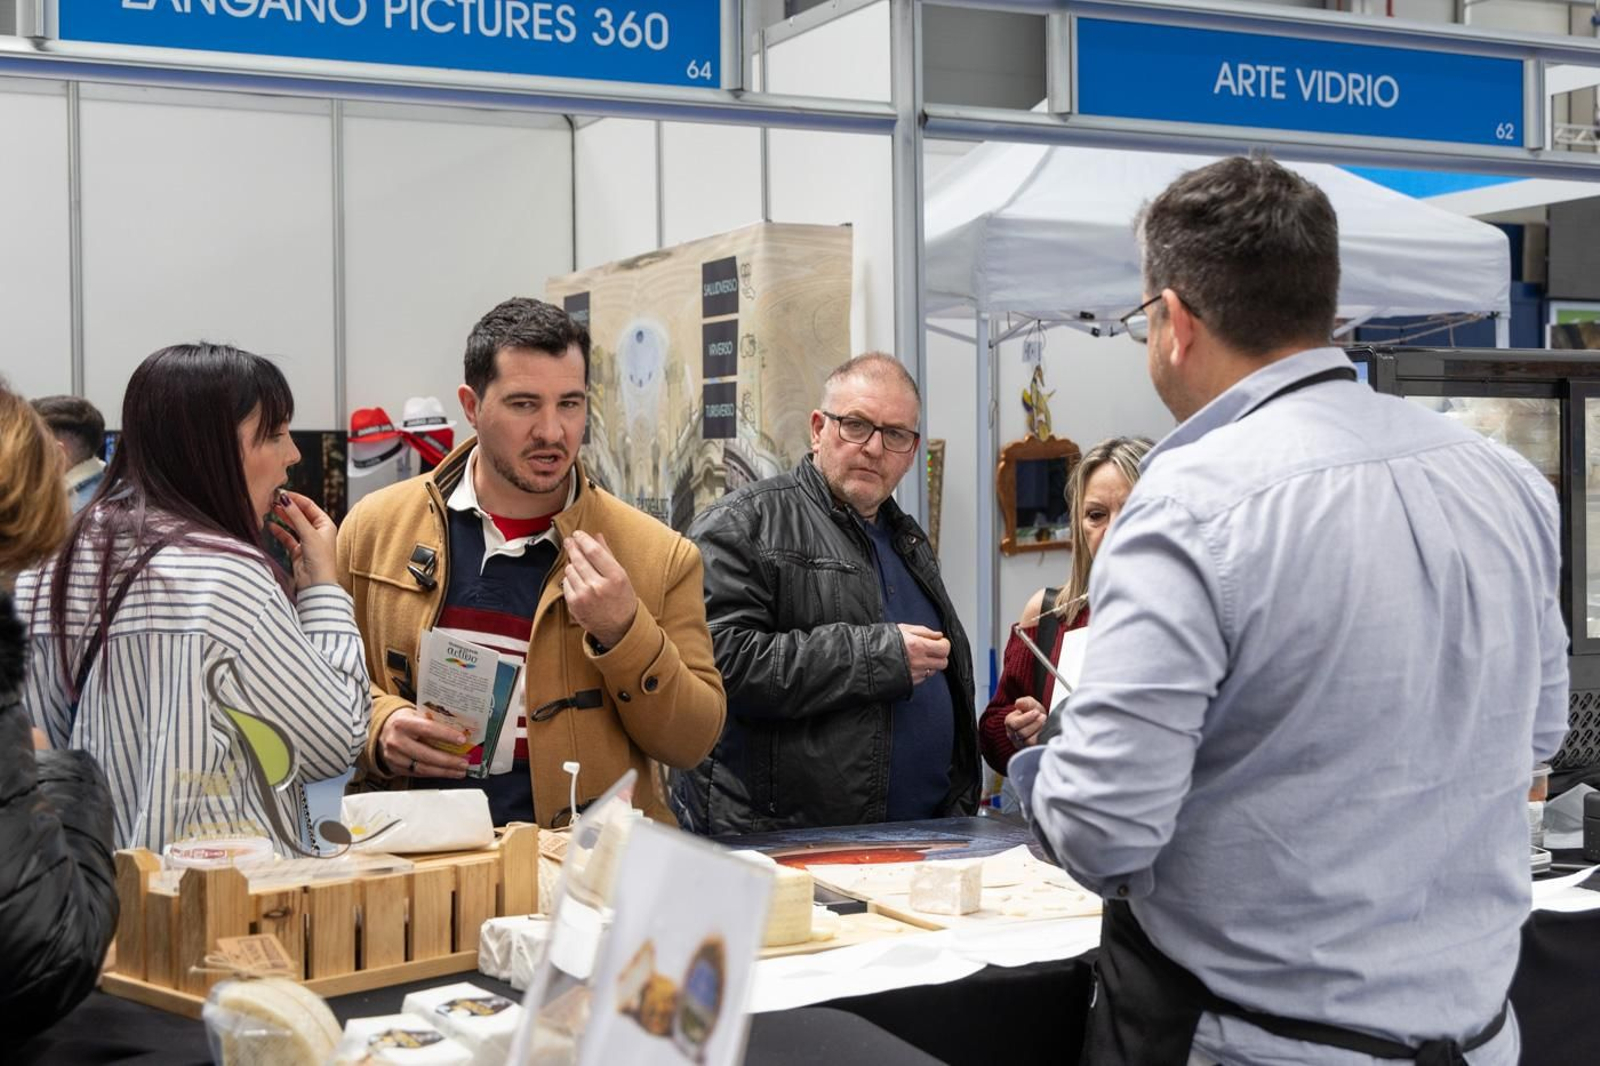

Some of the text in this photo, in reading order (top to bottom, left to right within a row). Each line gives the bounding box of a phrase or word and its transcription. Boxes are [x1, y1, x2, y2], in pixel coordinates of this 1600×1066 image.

[121, 0, 669, 50] GANO PICTURES 360
[686, 60, 712, 80] 64
[1213, 62, 1400, 108] ARTE VIDRIO
[1496, 123, 1514, 140] 62
